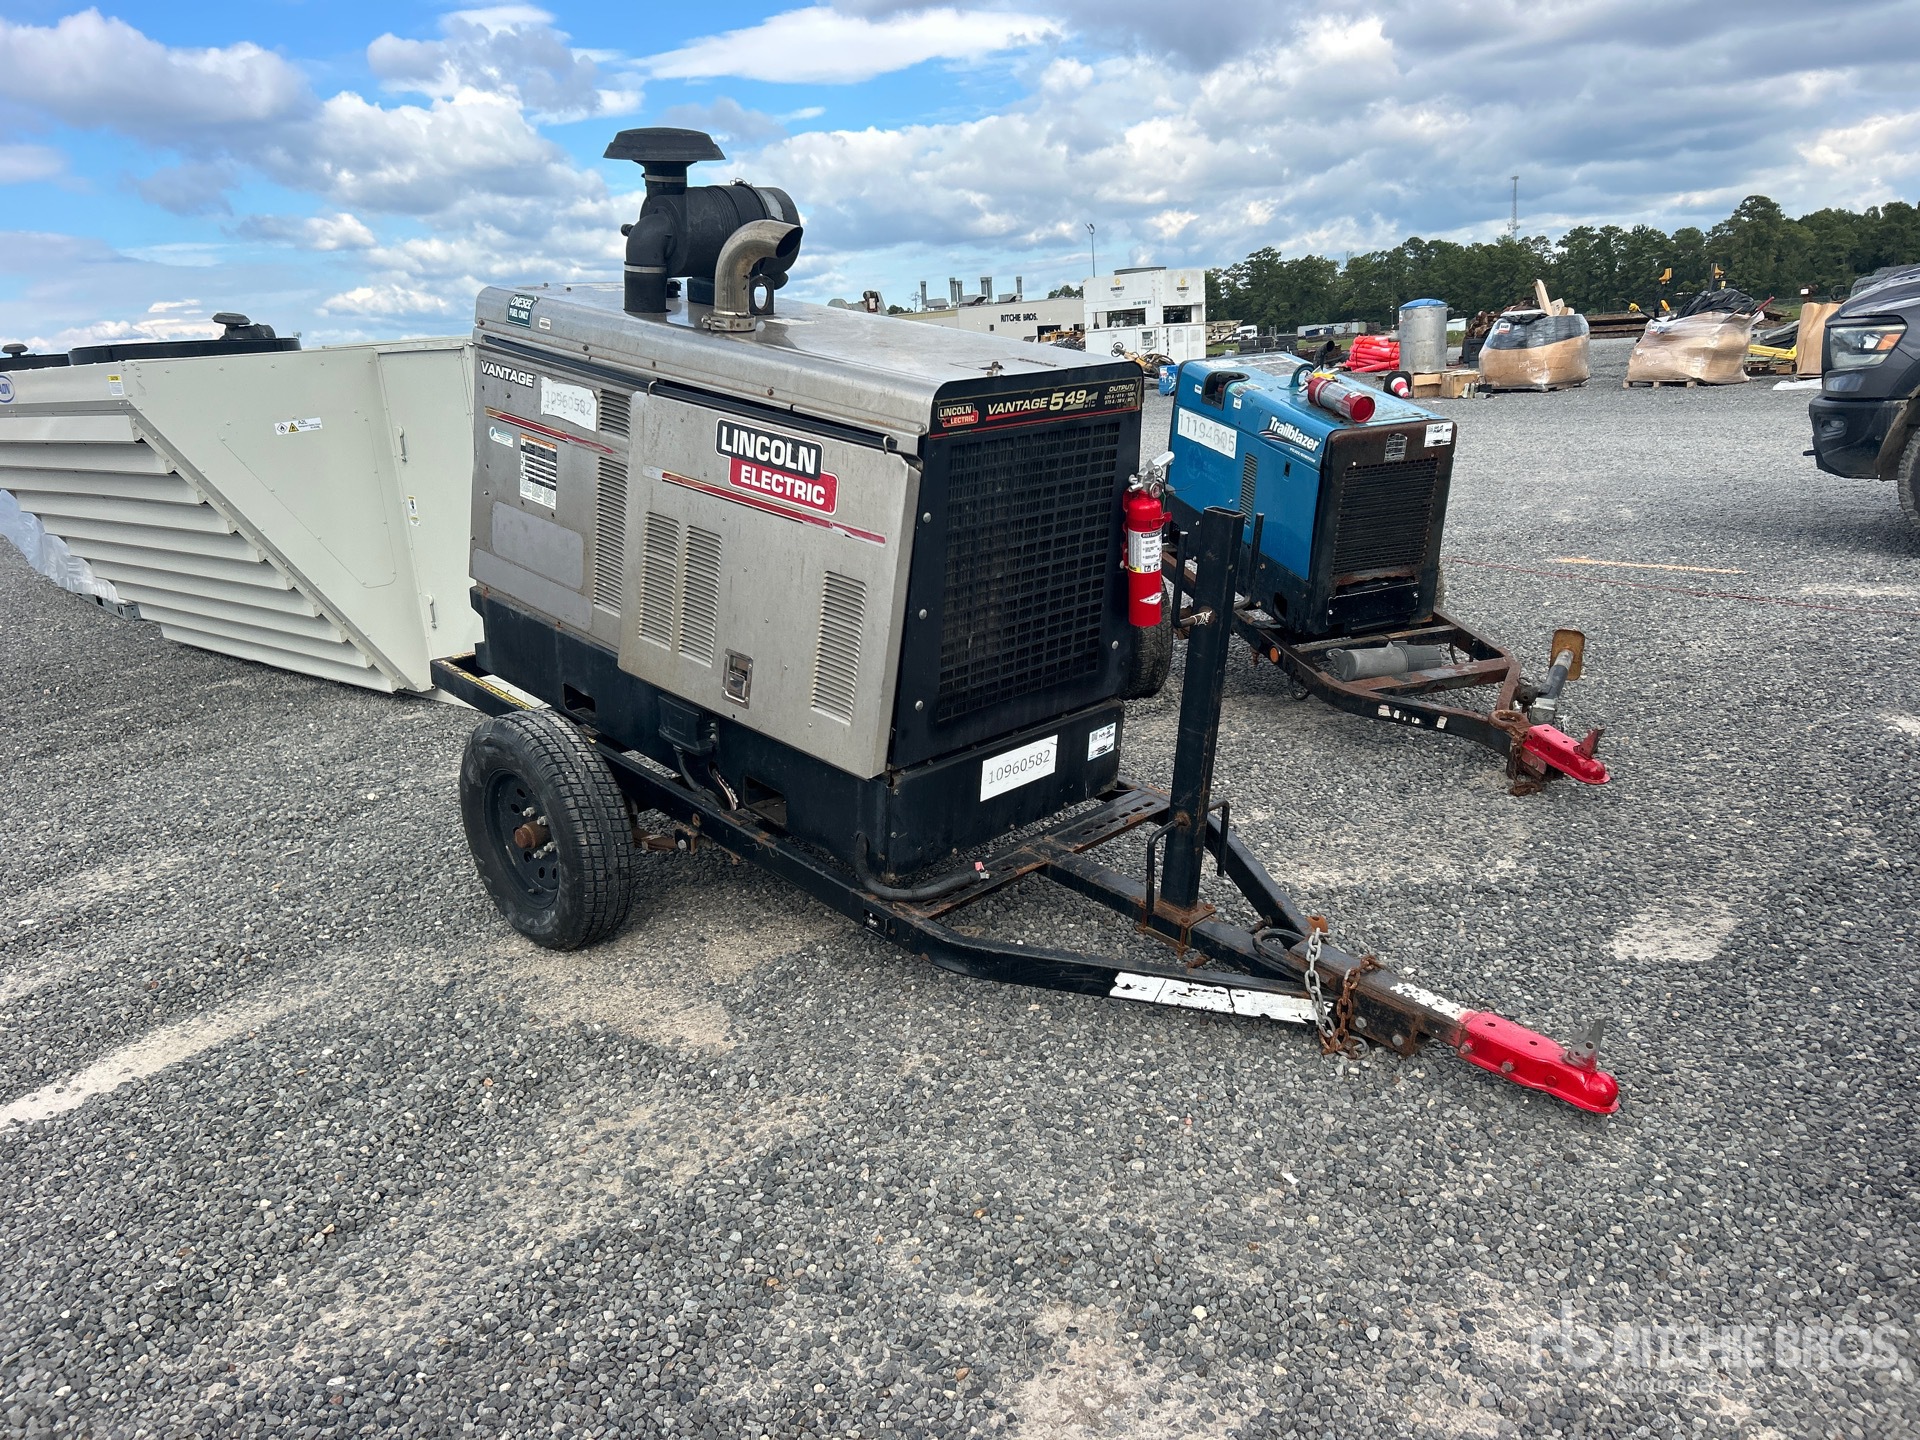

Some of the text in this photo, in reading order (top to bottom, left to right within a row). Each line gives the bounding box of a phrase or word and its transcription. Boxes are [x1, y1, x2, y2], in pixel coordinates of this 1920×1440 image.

[509, 308, 529, 320] FUEL ONLY
[511, 297, 533, 309] DIESEL
[1000, 314, 1021, 322] RITCHIE
[481, 360, 534, 388] VANTAGE
[545, 391, 592, 416] 10960582
[940, 405, 972, 418] LINCOLN
[988, 397, 1049, 415] VANTAGE
[1049, 389, 1087, 411] 549
[947, 415, 975, 425] LECTRIC
[1180, 413, 1236, 452] 11194605
[1269, 416, 1319, 451] Trailblazer
[721, 425, 816, 475] LINCOLN
[740, 464, 826, 505] ELECTRIC
[988, 749, 1051, 785] 10960582
